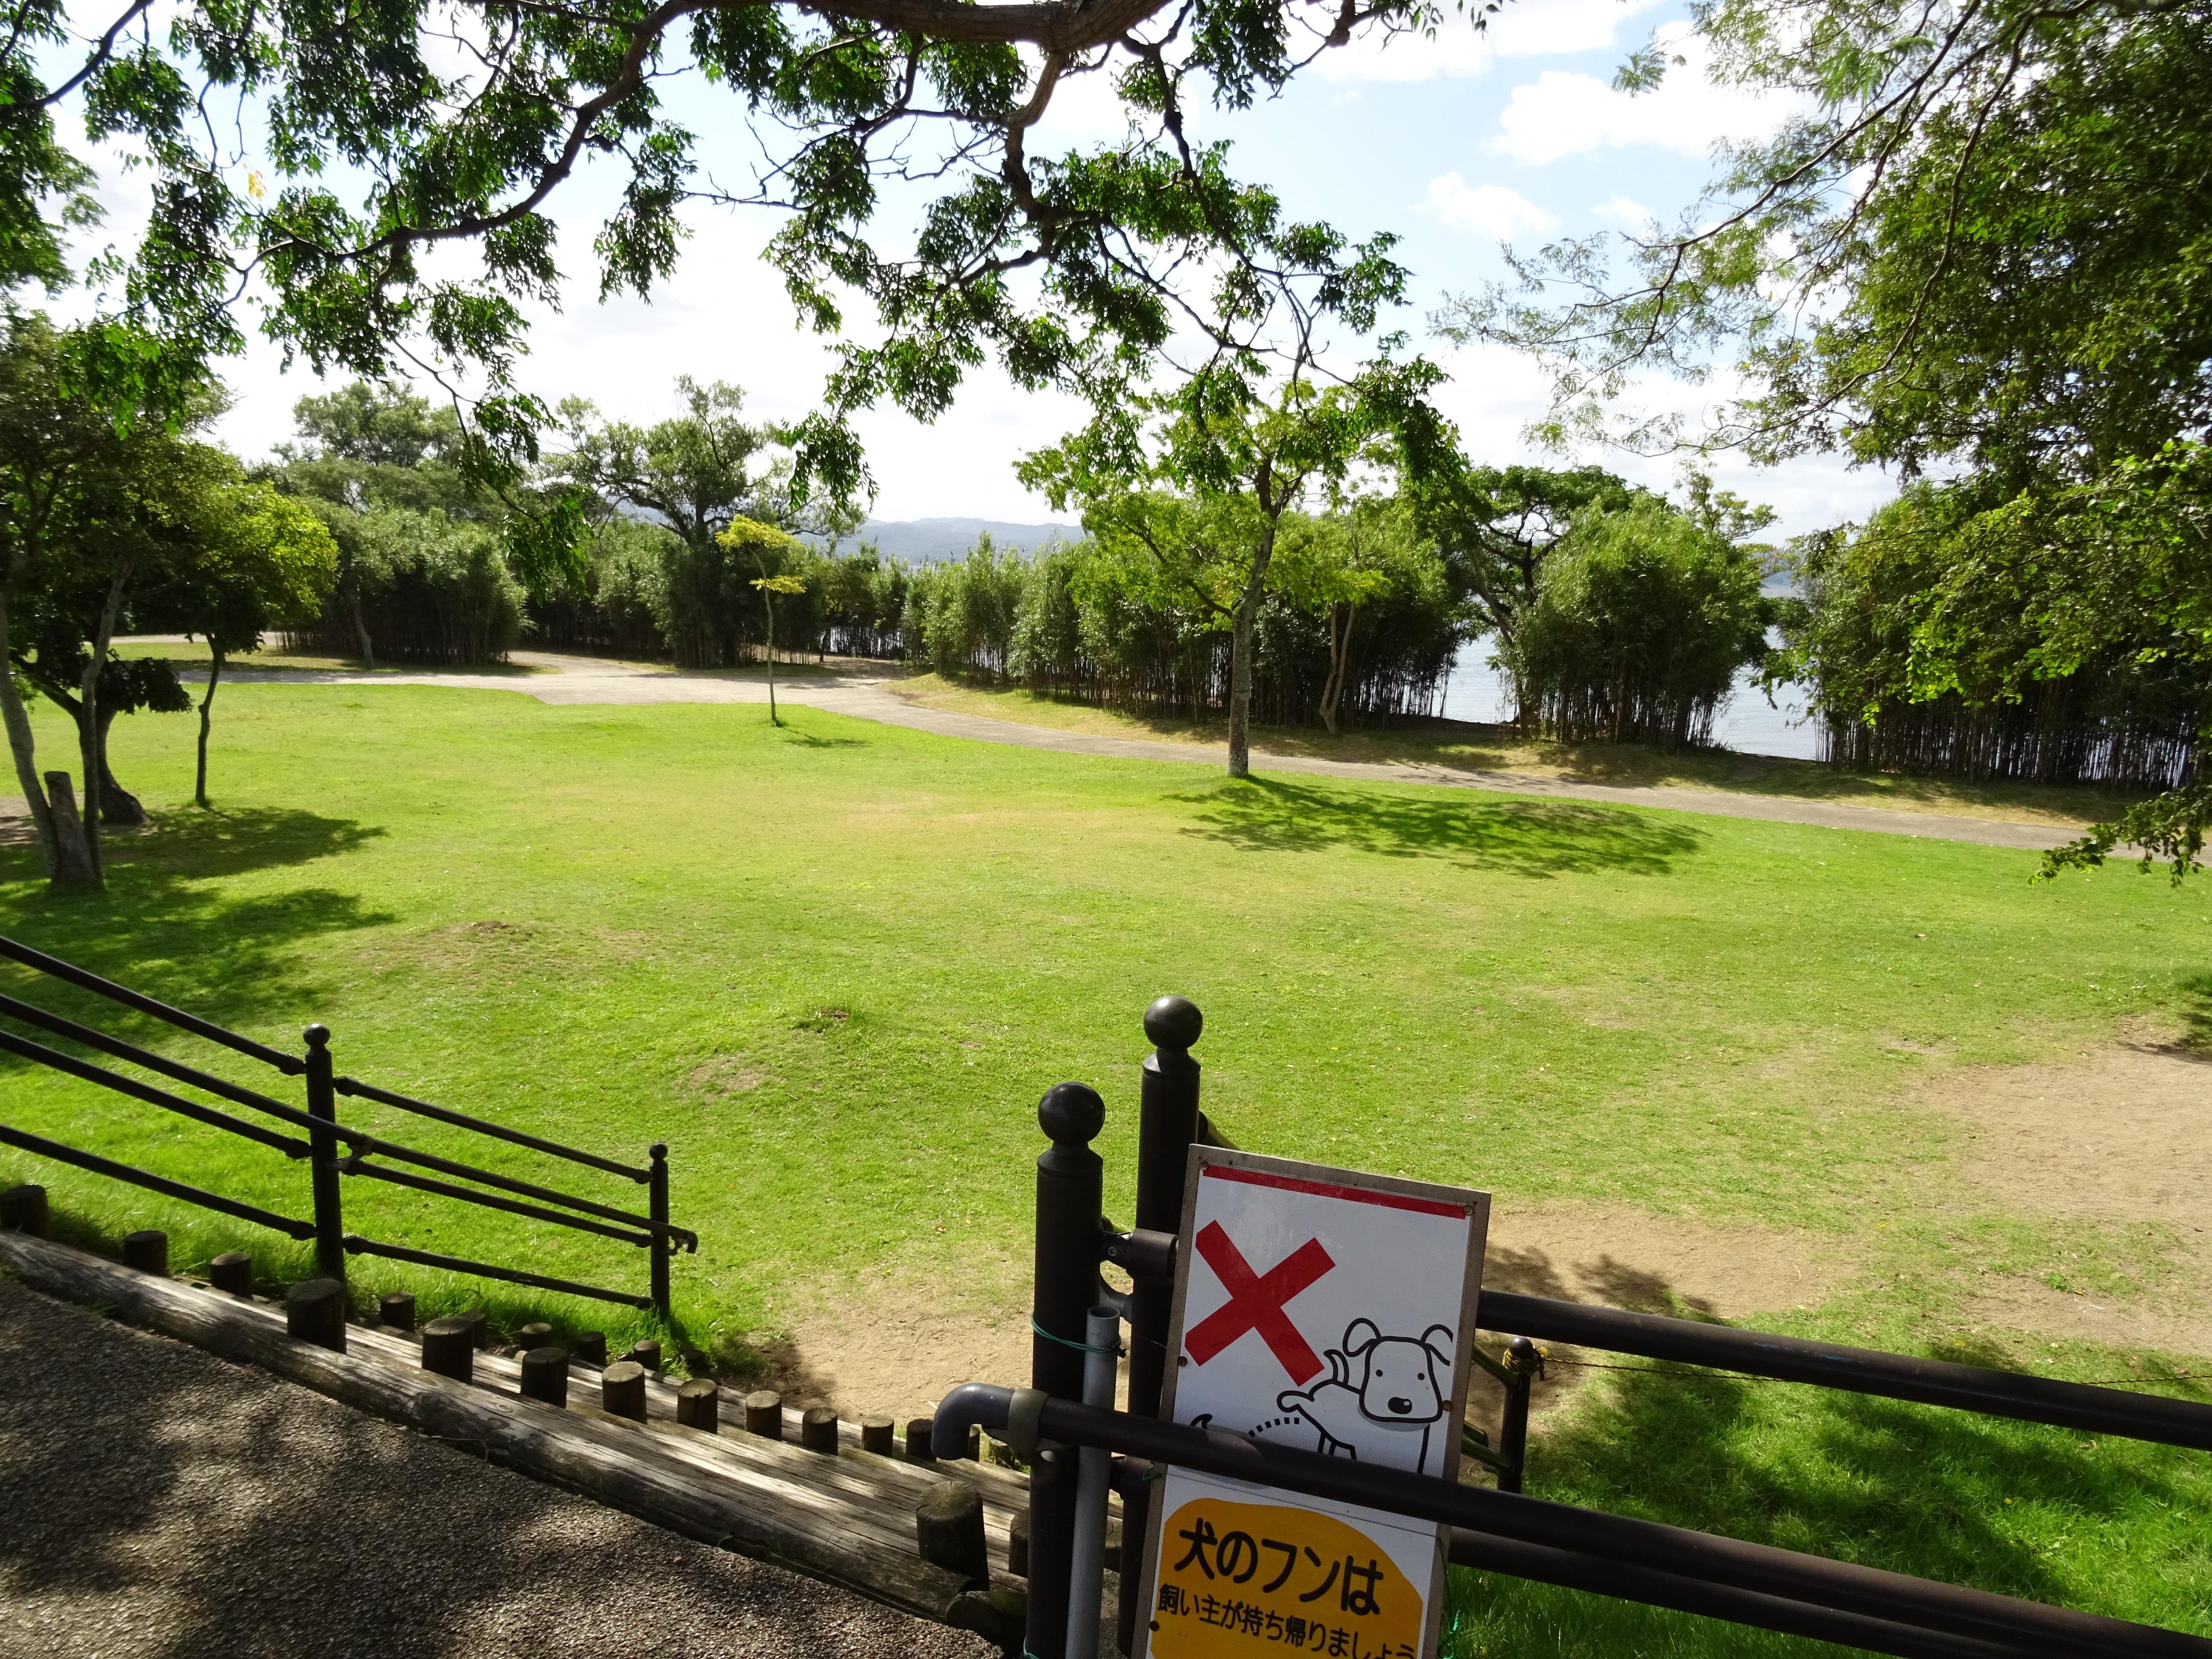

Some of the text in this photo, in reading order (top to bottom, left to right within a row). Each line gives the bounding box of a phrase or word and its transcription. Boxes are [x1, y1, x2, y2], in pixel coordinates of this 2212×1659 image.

[1174, 1517, 1383, 1615] 犬のフンは
